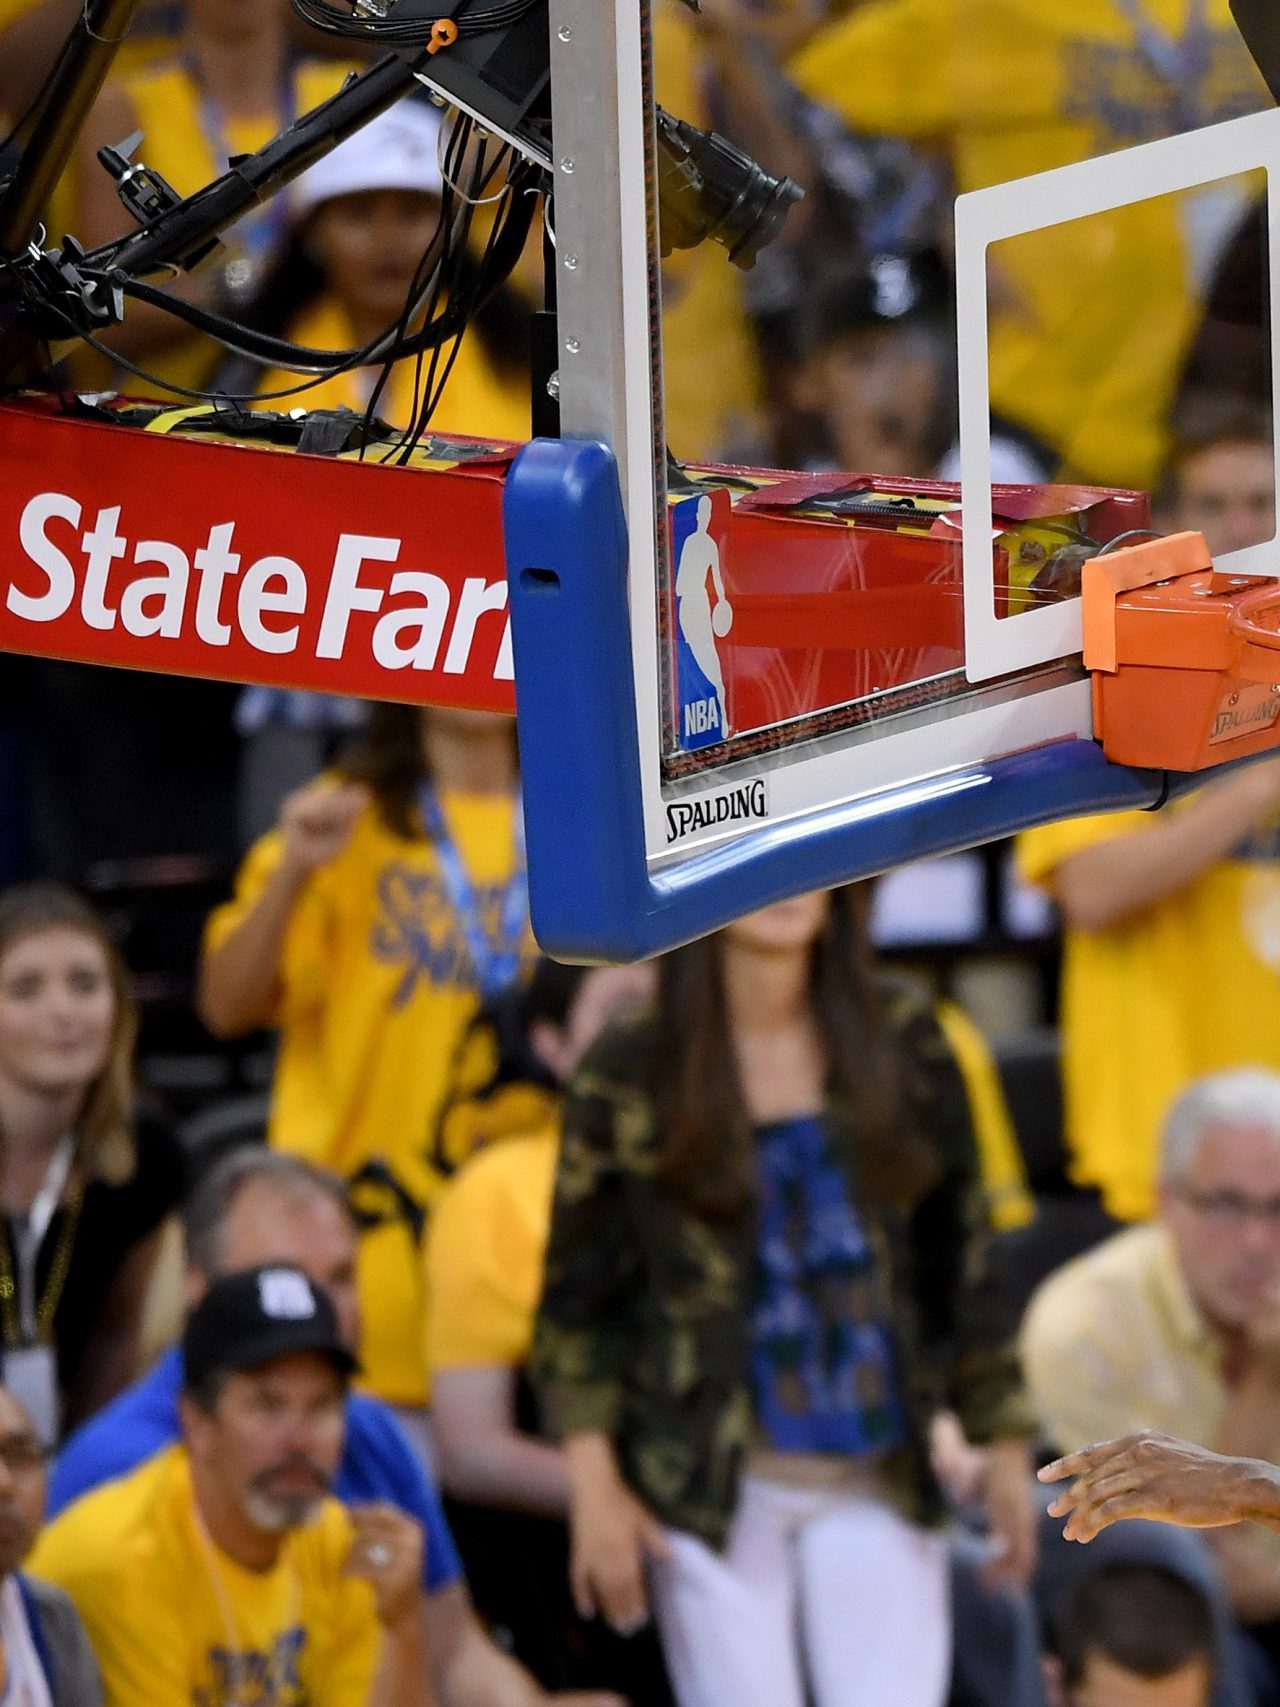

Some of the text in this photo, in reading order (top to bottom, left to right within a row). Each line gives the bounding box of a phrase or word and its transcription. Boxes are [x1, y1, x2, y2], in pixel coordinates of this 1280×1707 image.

[684, 697, 719, 737] NBA
[1210, 697, 1279, 737] SPALDING
[666, 780, 765, 843] SPALDING
